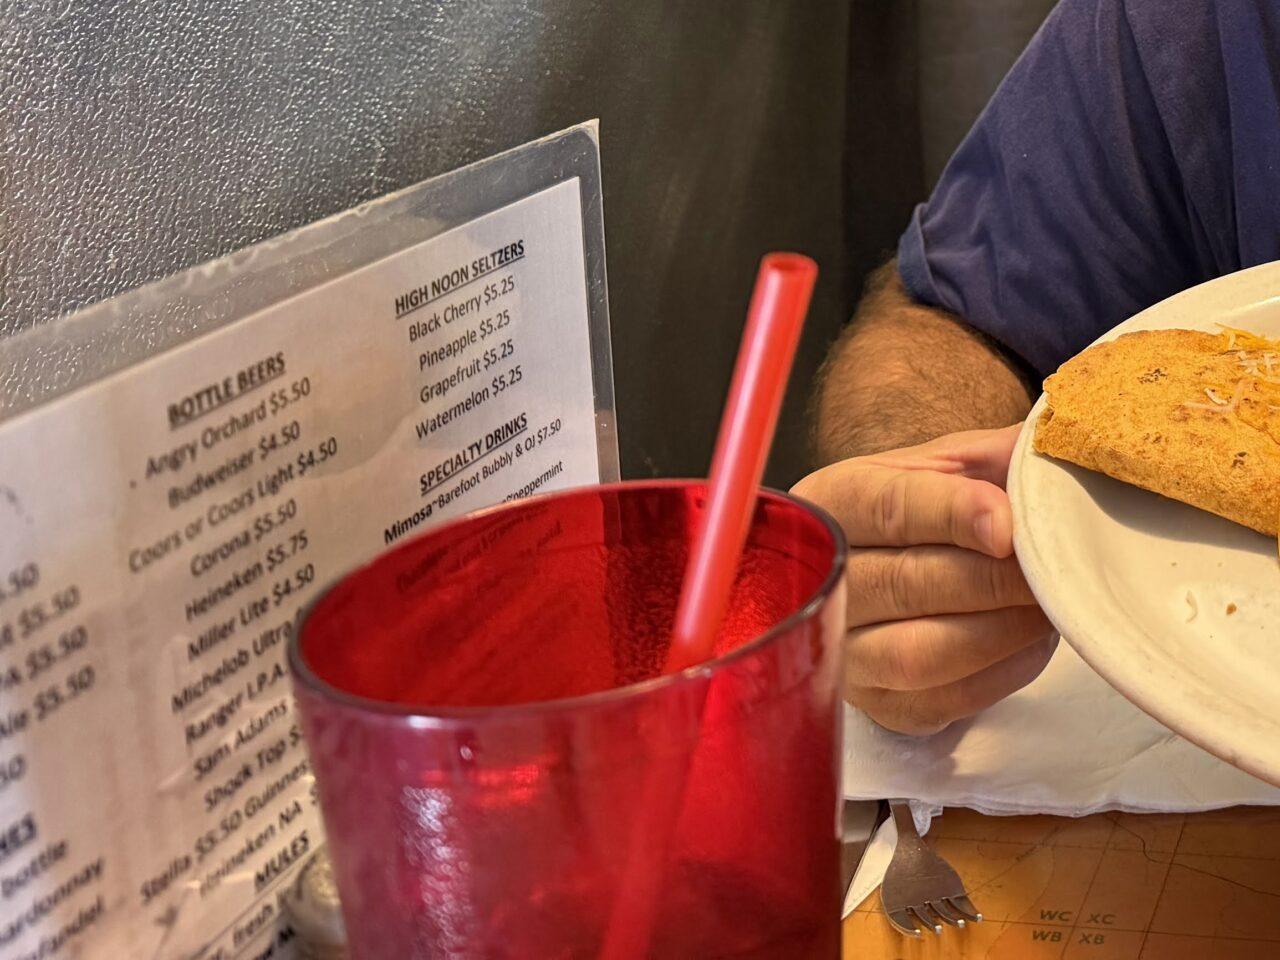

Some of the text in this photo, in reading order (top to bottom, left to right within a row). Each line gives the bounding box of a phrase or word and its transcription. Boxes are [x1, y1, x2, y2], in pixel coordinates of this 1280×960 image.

[395, 240, 525, 315] HIGH NOON SELTZERS
[408, 275, 515, 344] Black Cherry $5.25
[419, 309, 511, 372] Pineapple $5.25
[420, 338, 515, 404] Grapefruit $5.25
[167, 351, 286, 426] BOTTLE BEERS
[415, 365, 523, 440] Watermelon $5.25
[145, 376, 311, 480] Angry Orchard $5.50
[167, 420, 301, 510] Budweiser $4.50
[419, 412, 529, 493] SPECIALTY DRINKS
[482, 450, 514, 482] Bubbly
[515, 443, 523, 459] &
[525, 434, 536, 453] OJ
[537, 418, 561, 446] $7.50
[128, 437, 338, 574] Coors or Coors Light $4.50
[190, 498, 298, 577] Corona $5.50
[18, 584, 80, 639] $5.50
[185, 529, 309, 622] Heineken $5.75
[188, 563, 315, 662] Miller Lite $4.50
[25, 624, 88, 680] $5.50
[171, 620, 293, 713] Michelob Ultra
[33, 664, 95, 722] $5.50
[185, 693, 243, 745] Ranger
[194, 743, 232, 781] Sam
[234, 700, 289, 749] Adams
[205, 740, 287, 813] Shock Top
[141, 855, 193, 905] Stella
[245, 760, 308, 818] Guinnes
[279, 800, 303, 830] NA
[255, 829, 310, 891] MULES
[1031, 928, 1062, 943] WB
[1040, 909, 1117, 925] WC XC
